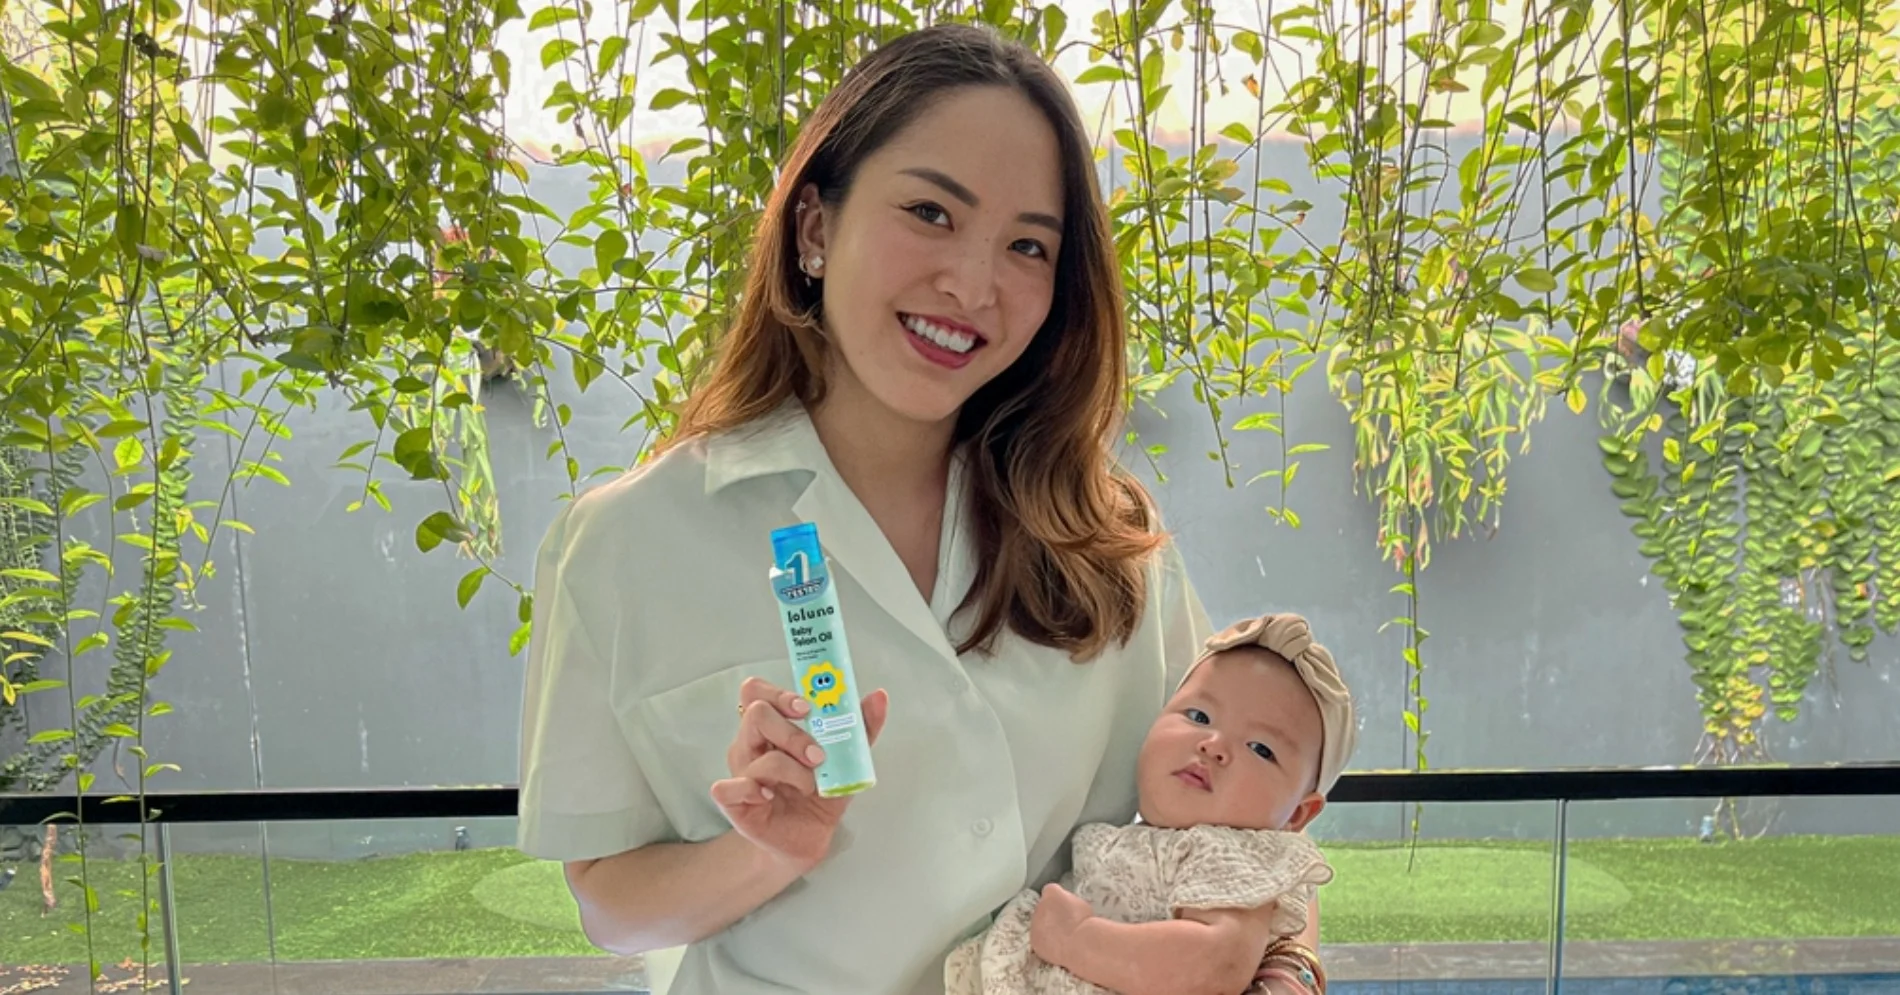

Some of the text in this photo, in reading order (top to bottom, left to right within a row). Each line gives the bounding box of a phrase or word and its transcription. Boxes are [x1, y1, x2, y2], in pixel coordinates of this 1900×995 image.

[784, 550, 809, 585] 1
[790, 626, 813, 637] Baby
[793, 631, 833, 647] Telon Oil
